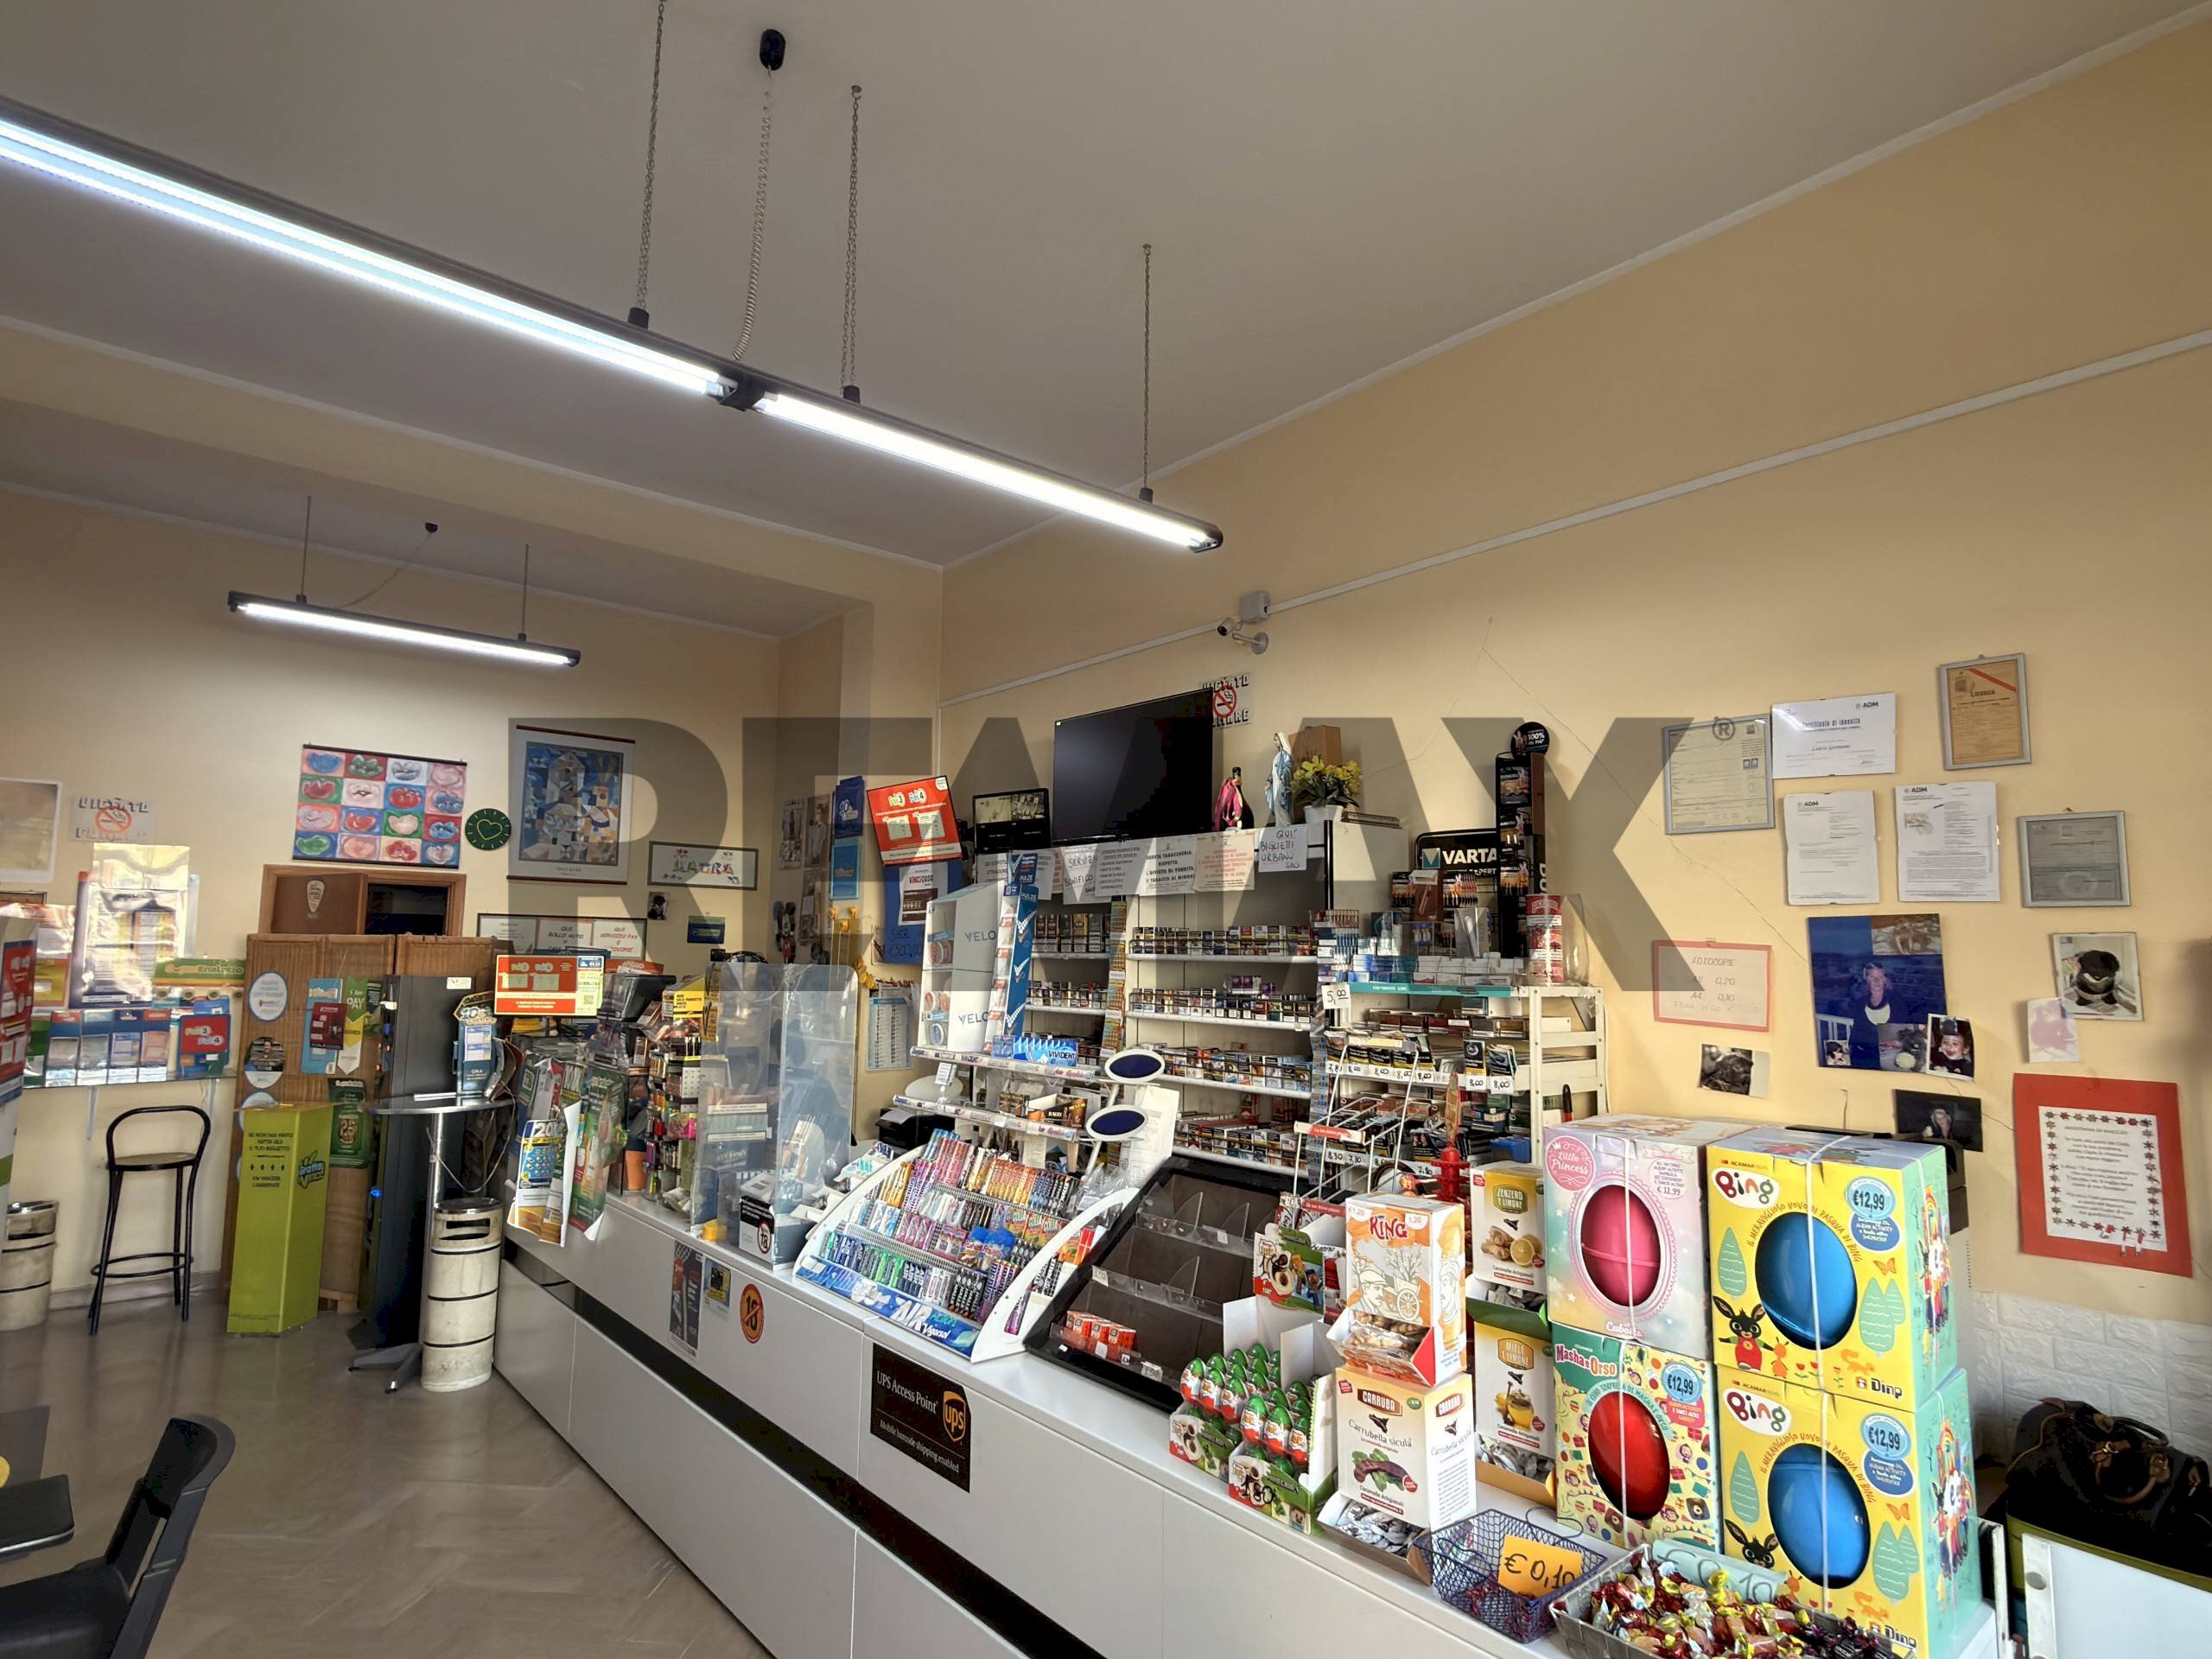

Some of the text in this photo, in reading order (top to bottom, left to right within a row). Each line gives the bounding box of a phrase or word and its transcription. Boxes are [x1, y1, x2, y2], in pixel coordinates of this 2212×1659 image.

[1442, 848, 1497, 865] VARTA
[964, 930, 996, 941] VELO
[1048, 1051, 1076, 1060] VIVIDENT
[1552, 1159, 1589, 1175] Princess
[1558, 1152, 1580, 1162] Little
[1497, 1188, 1523, 1201] ZENZERO
[1715, 1170, 1775, 1205] Bing
[1853, 1190, 1885, 1211] €12,99
[1370, 1216, 1408, 1241] KING
[891, 1298, 933, 1332] AIR
[921, 1322, 950, 1339] Vigorsol
[1556, 1344, 1585, 1367] Masha
[1590, 1357, 1616, 1376] Orso
[877, 1370, 938, 1414] UPS Access Point
[1667, 1374, 1693, 1395] €12,99
[1363, 1390, 1395, 1412] CARRUBA
[1636, 1389, 1654, 1410] MASHA
[944, 1404, 964, 1433] ups
[1727, 1391, 1787, 1433] Bing
[1349, 1419, 1387, 1444] Carrubella
[1868, 1427, 1900, 1452] €12,99
[880, 1420, 959, 1472] Mobile barcode shipping enabled
